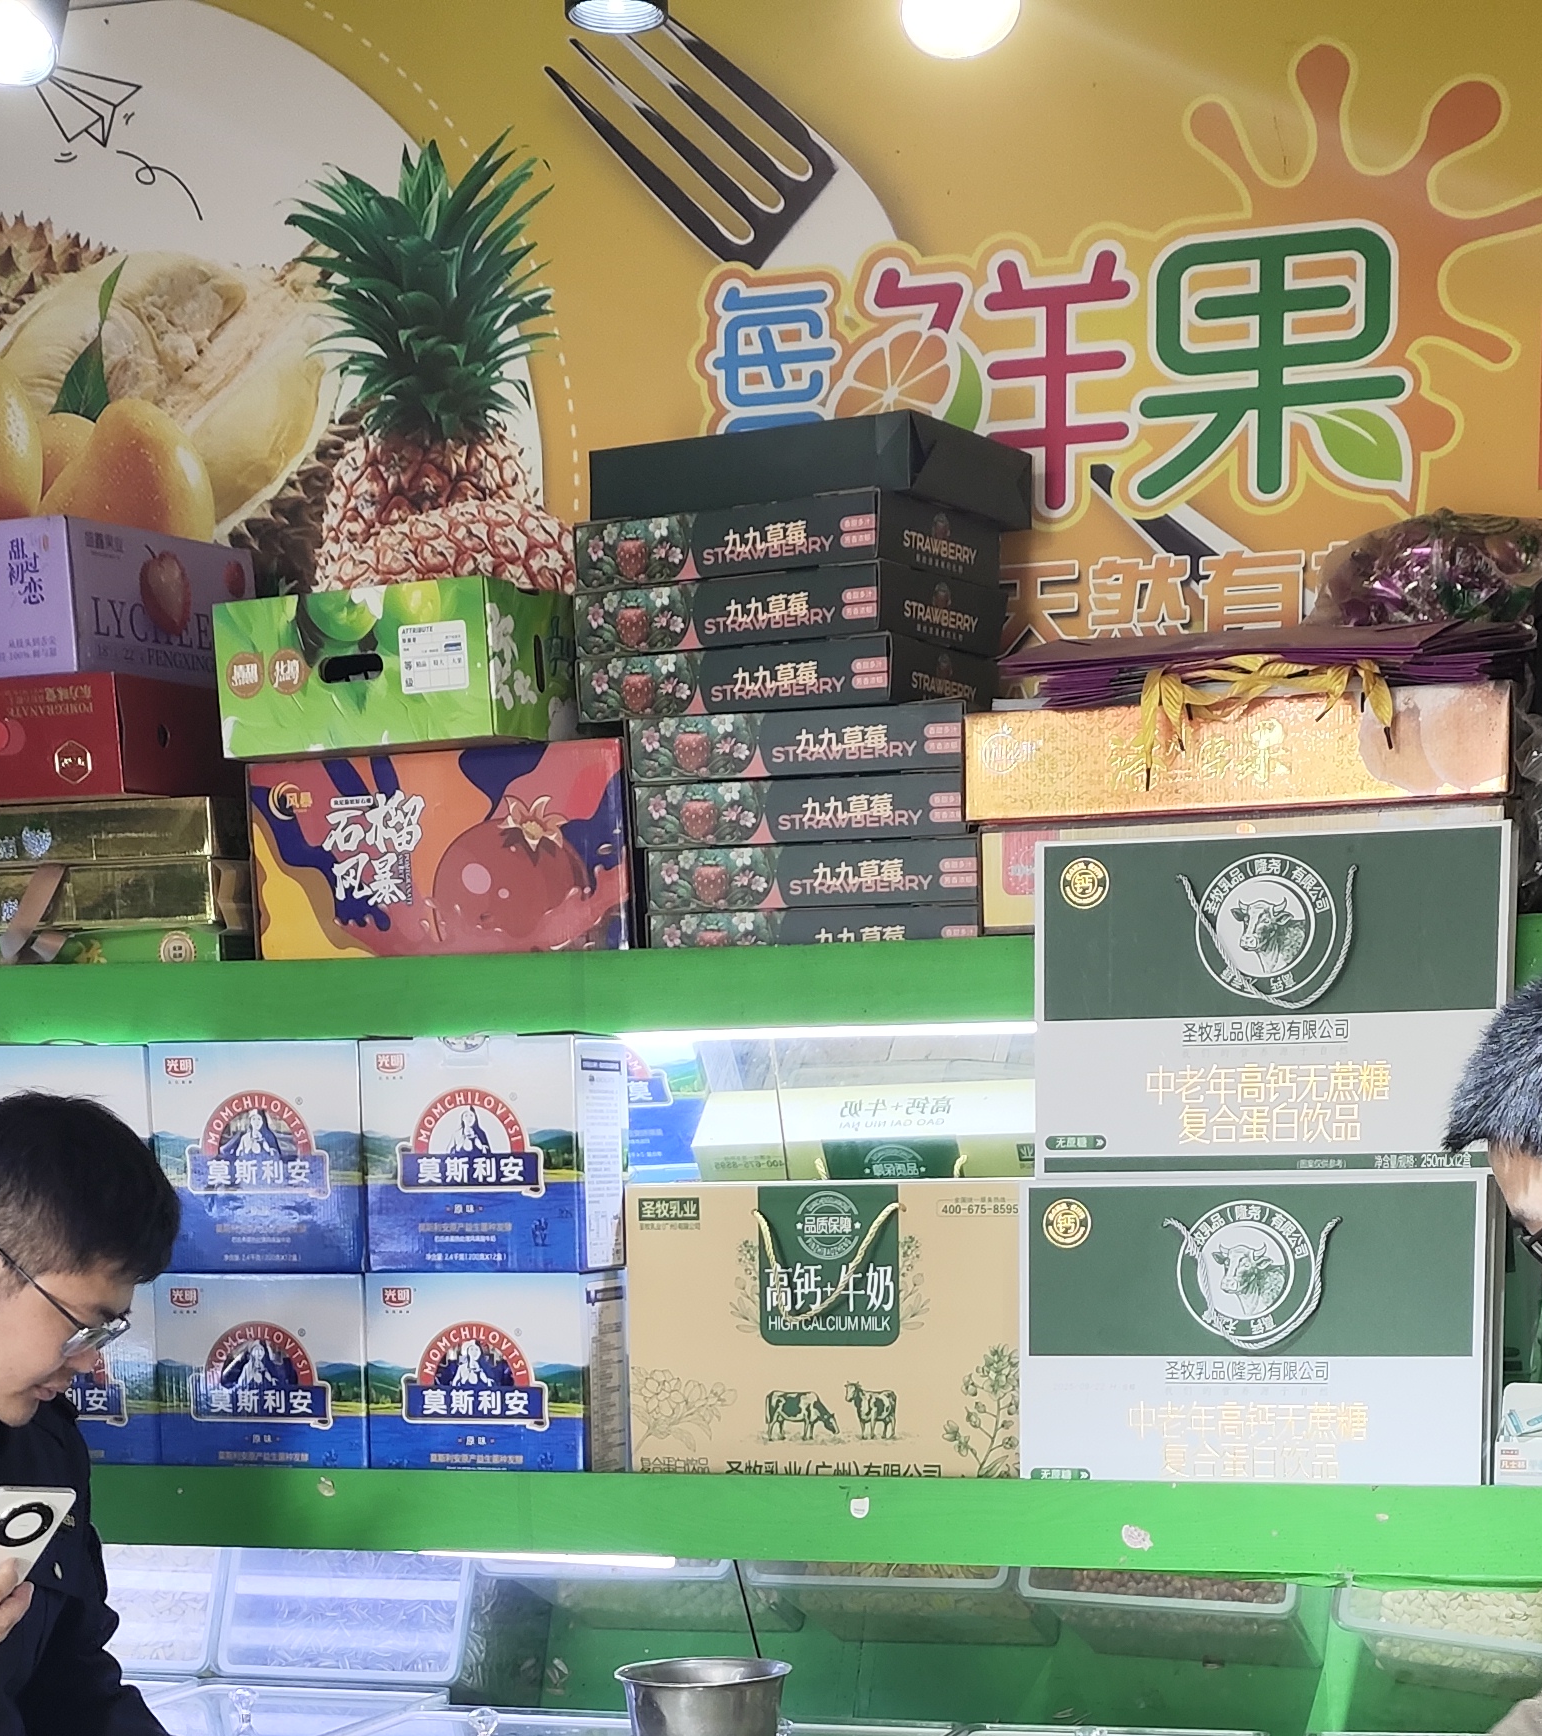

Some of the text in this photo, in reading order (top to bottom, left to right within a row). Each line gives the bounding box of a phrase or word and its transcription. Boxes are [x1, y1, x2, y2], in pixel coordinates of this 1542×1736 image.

[723, 519, 808, 556] 九九草莓
[902, 528, 977, 566] STRAWBERRY
[725, 591, 809, 626] 九九草莓
[903, 599, 978, 634] STRAWBERRY
[732, 660, 819, 694] 九九草莓
[794, 723, 889, 756] 九九草莓
[801, 792, 894, 823] 九九草莓
[812, 858, 905, 887] 九九草莓
[1181, 1019, 1350, 1043] 圣牧乳品(隆尧)有限公司
[1145, 1060, 1392, 1106] 中老年高钙无蔗糖
[1177, 1104, 1362, 1145] 复合蛋白饮品
[207, 1159, 311, 1186] 莫斯利安
[417, 1156, 527, 1184] 莫斯利安
[640, 1200, 698, 1220] 圣牧乳业
[803, 1215, 853, 1235] 品质保障
[941, 1202, 1020, 1217] 400-675-8595
[764, 1262, 896, 1313] 高钙+牛奶
[801, 1314, 859, 1332] CALCIUM
[860, 1315, 892, 1332] MILK
[1165, 1359, 1331, 1382] 圣牧乳品(隆尧)有限公司
[209, 1388, 315, 1416] 莫斯利安
[421, 1389, 531, 1417] 莫斯利安
[1127, 1400, 1370, 1442] 中老年高钙无蔗糖
[1159, 1443, 1339, 1481] 复合蛋白饮品
